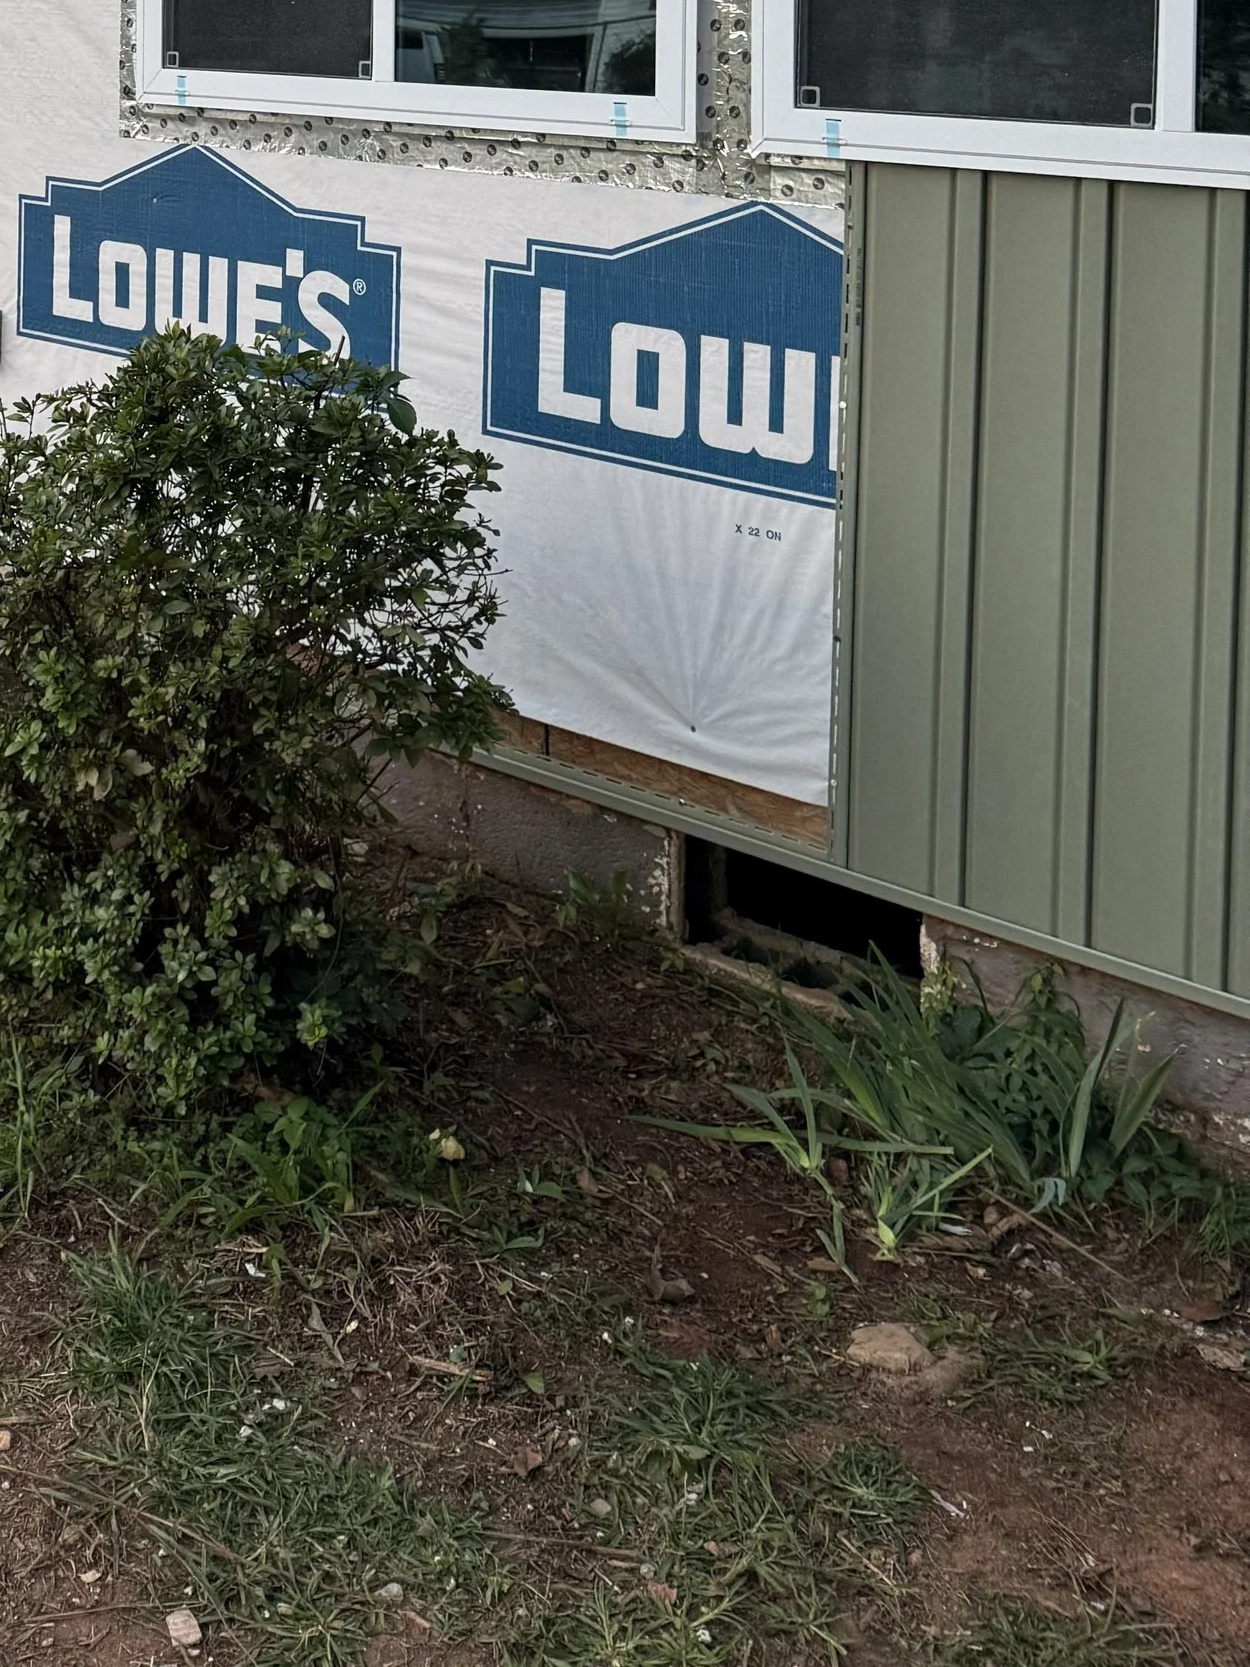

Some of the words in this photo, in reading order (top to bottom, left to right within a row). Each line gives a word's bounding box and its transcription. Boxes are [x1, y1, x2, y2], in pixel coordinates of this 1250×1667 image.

[734, 523, 743, 534] X
[748, 526, 760, 537] 22
[766, 529, 782, 541] ON
